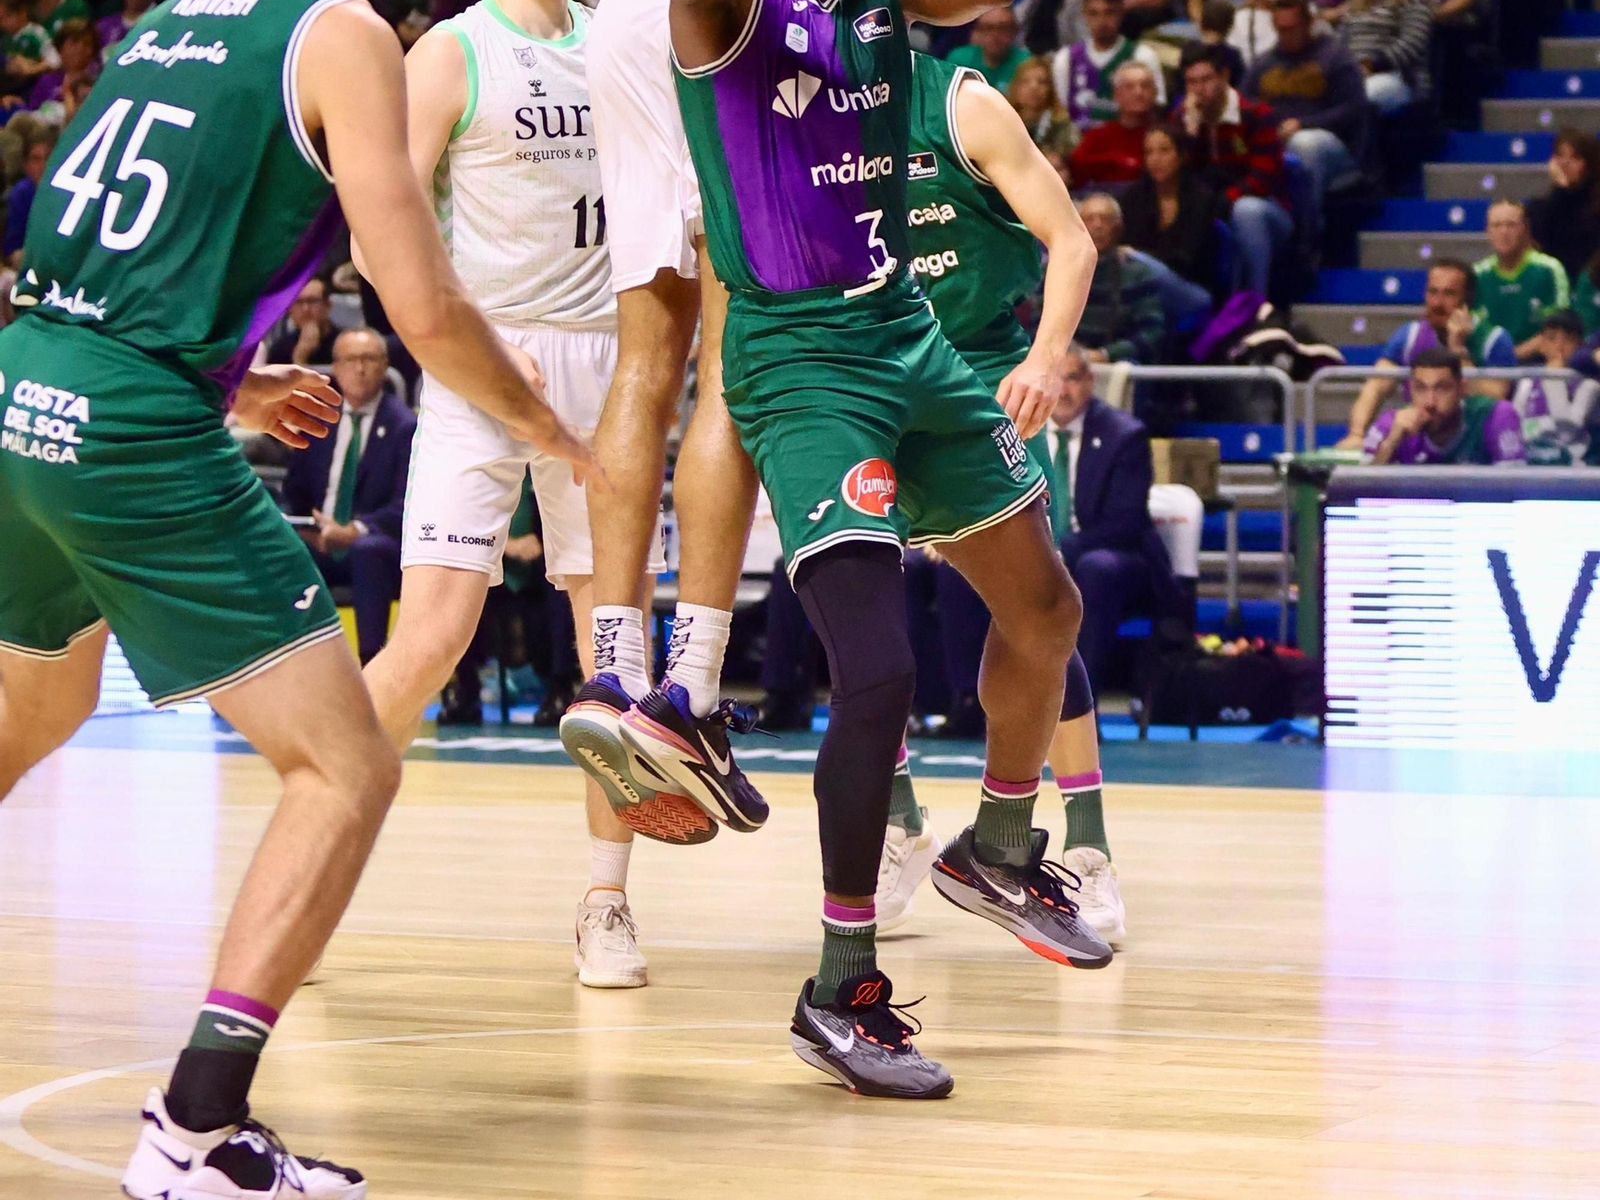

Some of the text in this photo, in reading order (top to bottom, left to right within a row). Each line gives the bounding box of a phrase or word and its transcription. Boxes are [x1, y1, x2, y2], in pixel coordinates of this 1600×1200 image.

[51, 97, 196, 251] 45
[516, 149, 570, 163] seguros
[13, 379, 90, 423] COSTA
[33, 415, 83, 445] SOL
[447, 534, 460, 543] EL
[1486, 549, 1600, 703] V
